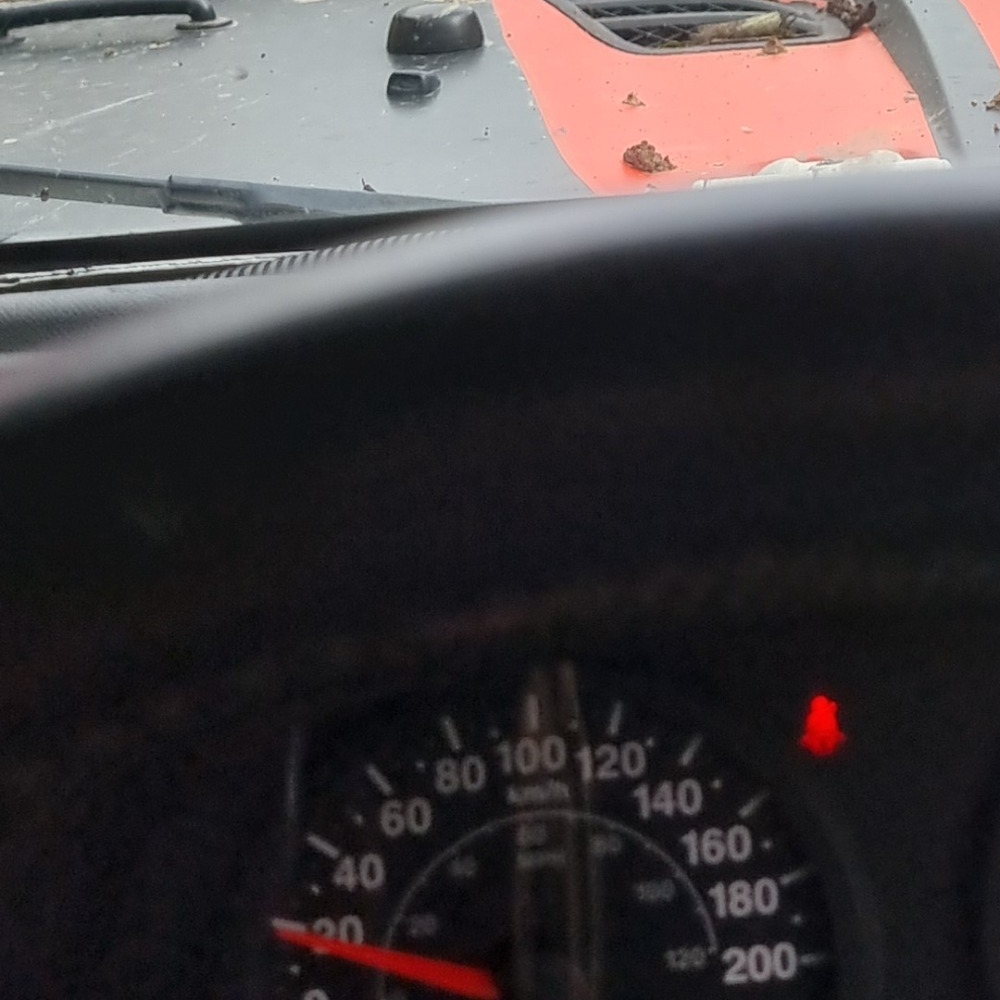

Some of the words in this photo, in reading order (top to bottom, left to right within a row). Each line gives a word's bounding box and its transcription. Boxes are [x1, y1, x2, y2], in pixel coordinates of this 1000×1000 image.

[434, 755, 486, 794] 80
[502, 735, 566, 774] 100
[576, 740, 647, 782] 120
[380, 799, 432, 838] 60
[633, 778, 703, 819] 140
[680, 824, 753, 867] 160
[332, 853, 386, 892] 40
[707, 877, 780, 919] 180
[721, 942, 798, 986] 200
